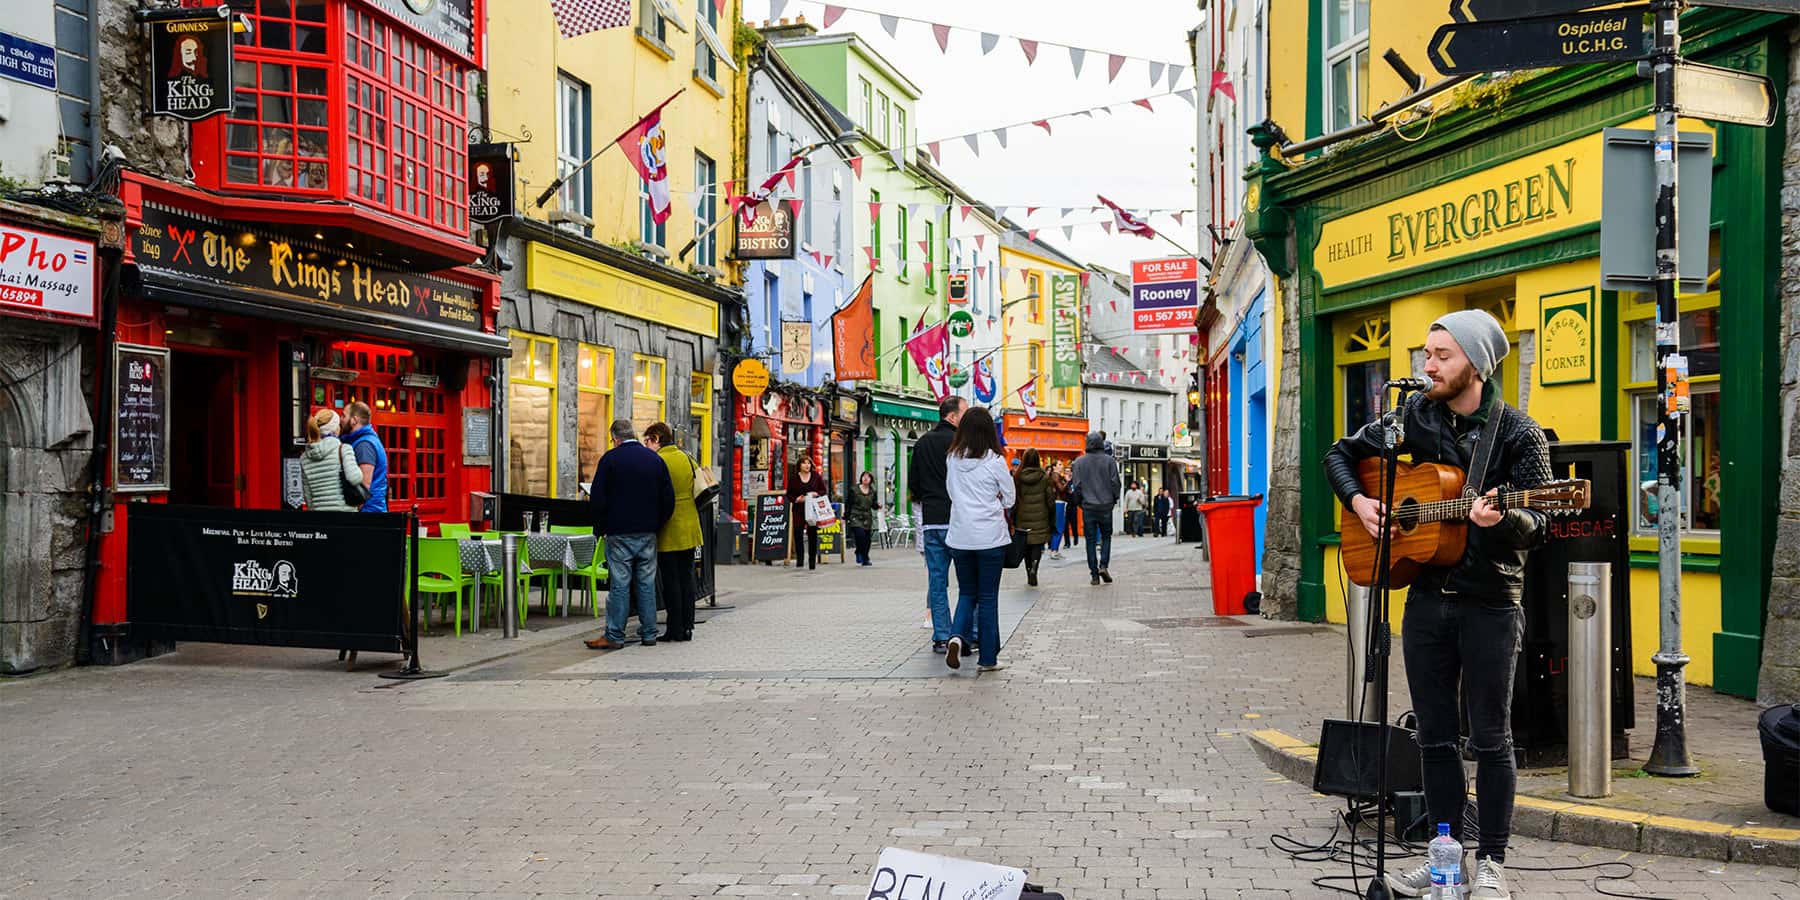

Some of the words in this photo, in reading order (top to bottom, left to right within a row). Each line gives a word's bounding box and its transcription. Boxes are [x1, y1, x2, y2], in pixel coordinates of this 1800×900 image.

[166, 22, 208, 33] GUINNESS
[1557, 17, 1627, 37] Ospidéal
[1562, 36, 1628, 55] U.C.H.G.
[21, 61, 54, 79] STREET
[181, 75, 196, 84] The
[167, 96, 210, 111] HEAD
[142, 241, 161, 260] 1649
[739, 237, 789, 250] BISTRO
[1328, 233, 1373, 263] HEALTH
[203, 231, 250, 274] The
[269, 240, 341, 301] Kings
[352, 261, 410, 308] Head
[1142, 263, 1162, 273] FOR
[1163, 261, 1188, 271] SALE
[0, 269, 21, 284] hai
[25, 273, 79, 296] Massage
[0, 288, 37, 303] 65894
[1140, 288, 1191, 301] Rooney
[1155, 311, 1174, 321] 567
[1175, 310, 1194, 320] 391
[1546, 355, 1586, 370] CORNER
[760, 521, 787, 531] Served
[764, 514, 784, 523] Food
[232, 579, 269, 591] HEAD
[867, 867, 946, 900] BEN
